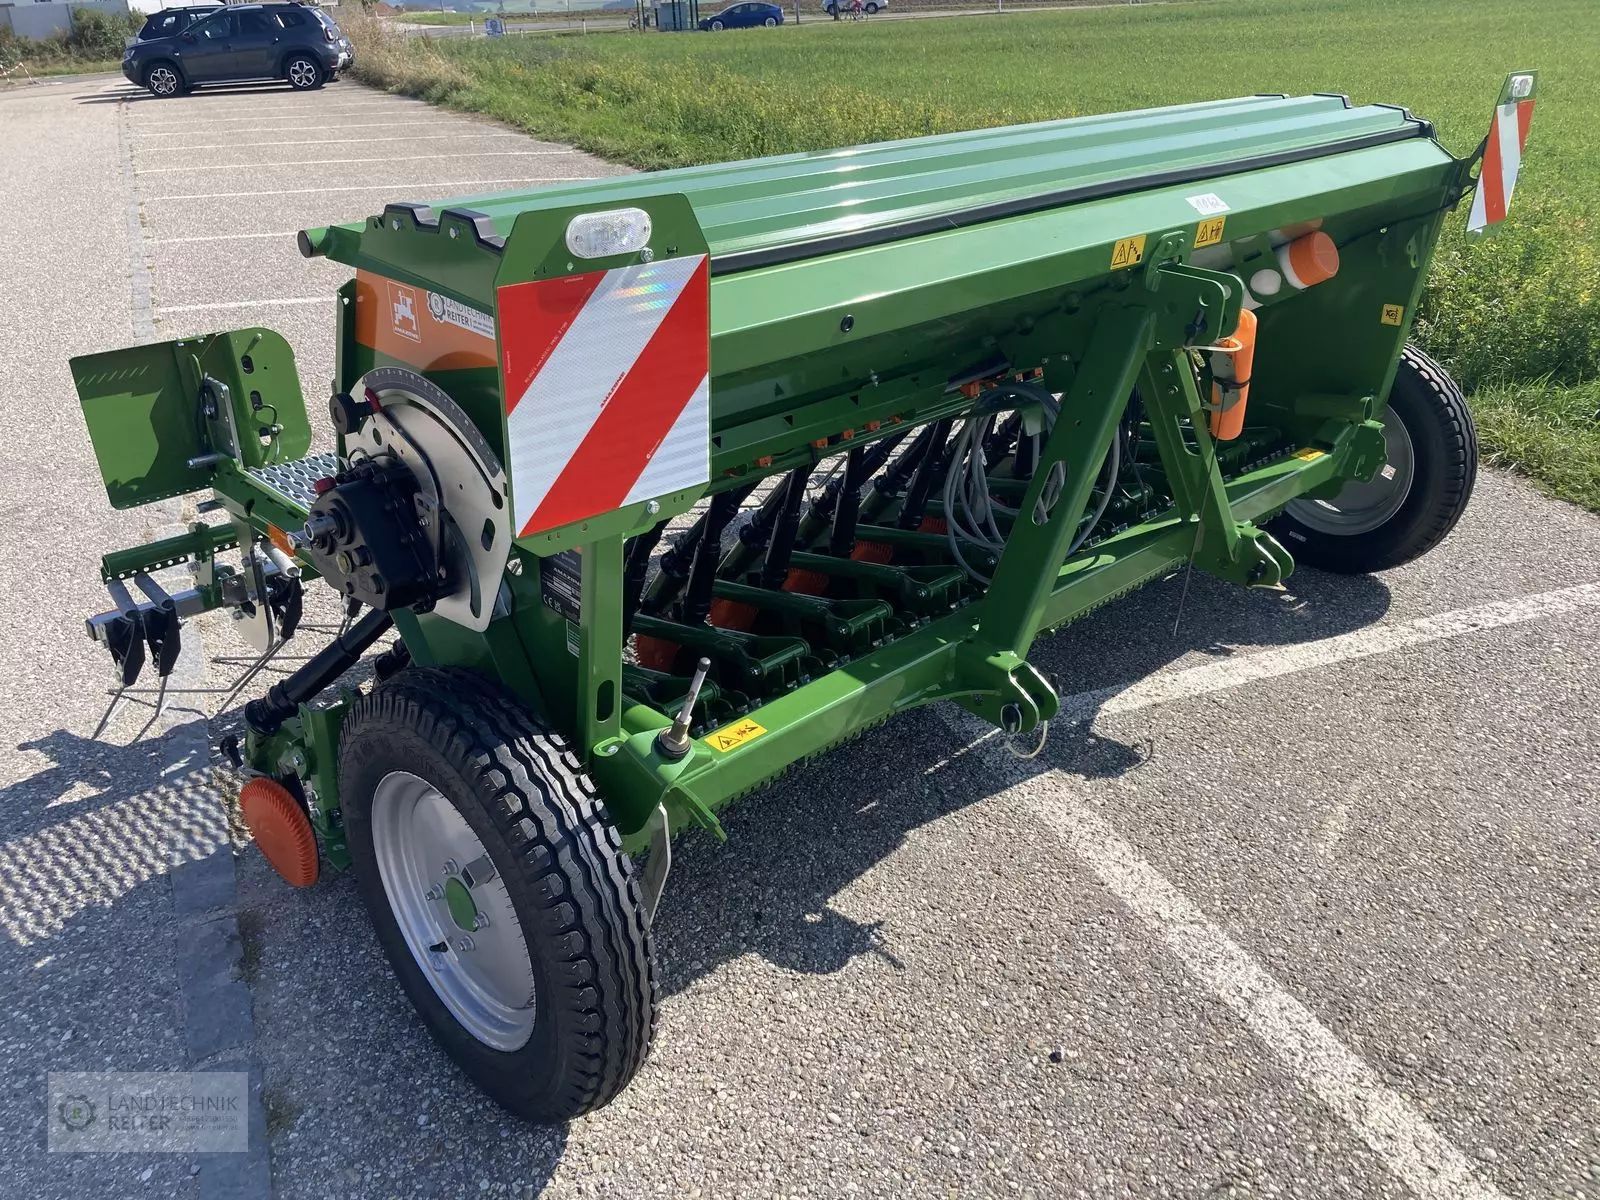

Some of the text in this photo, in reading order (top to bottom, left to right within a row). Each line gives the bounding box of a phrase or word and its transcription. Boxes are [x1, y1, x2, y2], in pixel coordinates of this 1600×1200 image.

[446, 297, 493, 323] LANDTECHNIK
[447, 309, 470, 327] REITER
[600, 371, 625, 408] AMAZONE
